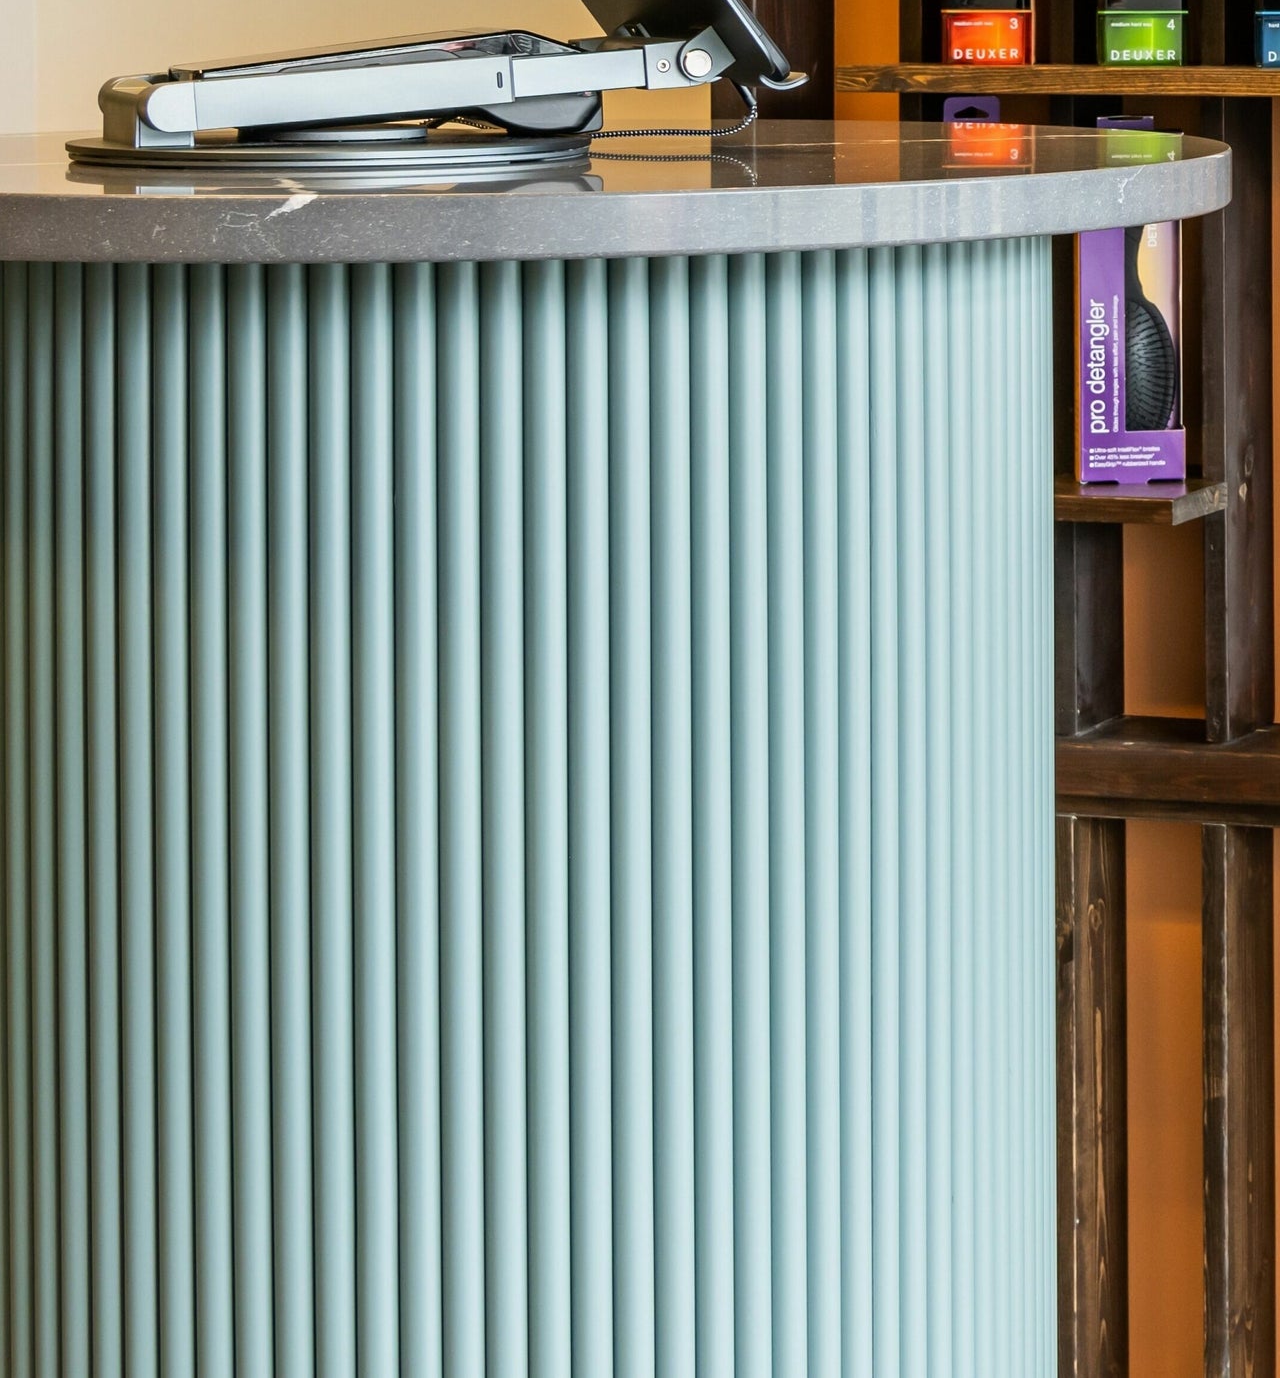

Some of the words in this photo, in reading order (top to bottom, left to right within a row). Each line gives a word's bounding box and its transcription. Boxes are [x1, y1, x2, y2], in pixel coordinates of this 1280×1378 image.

[1010, 18, 1018, 29] 3
[1167, 19, 1175, 29] 4
[954, 49, 1018, 59] DEUXER
[1111, 50, 1175, 60] DEUXER
[1086, 300, 1109, 394] detangler
[1090, 400, 1110, 433] pro
